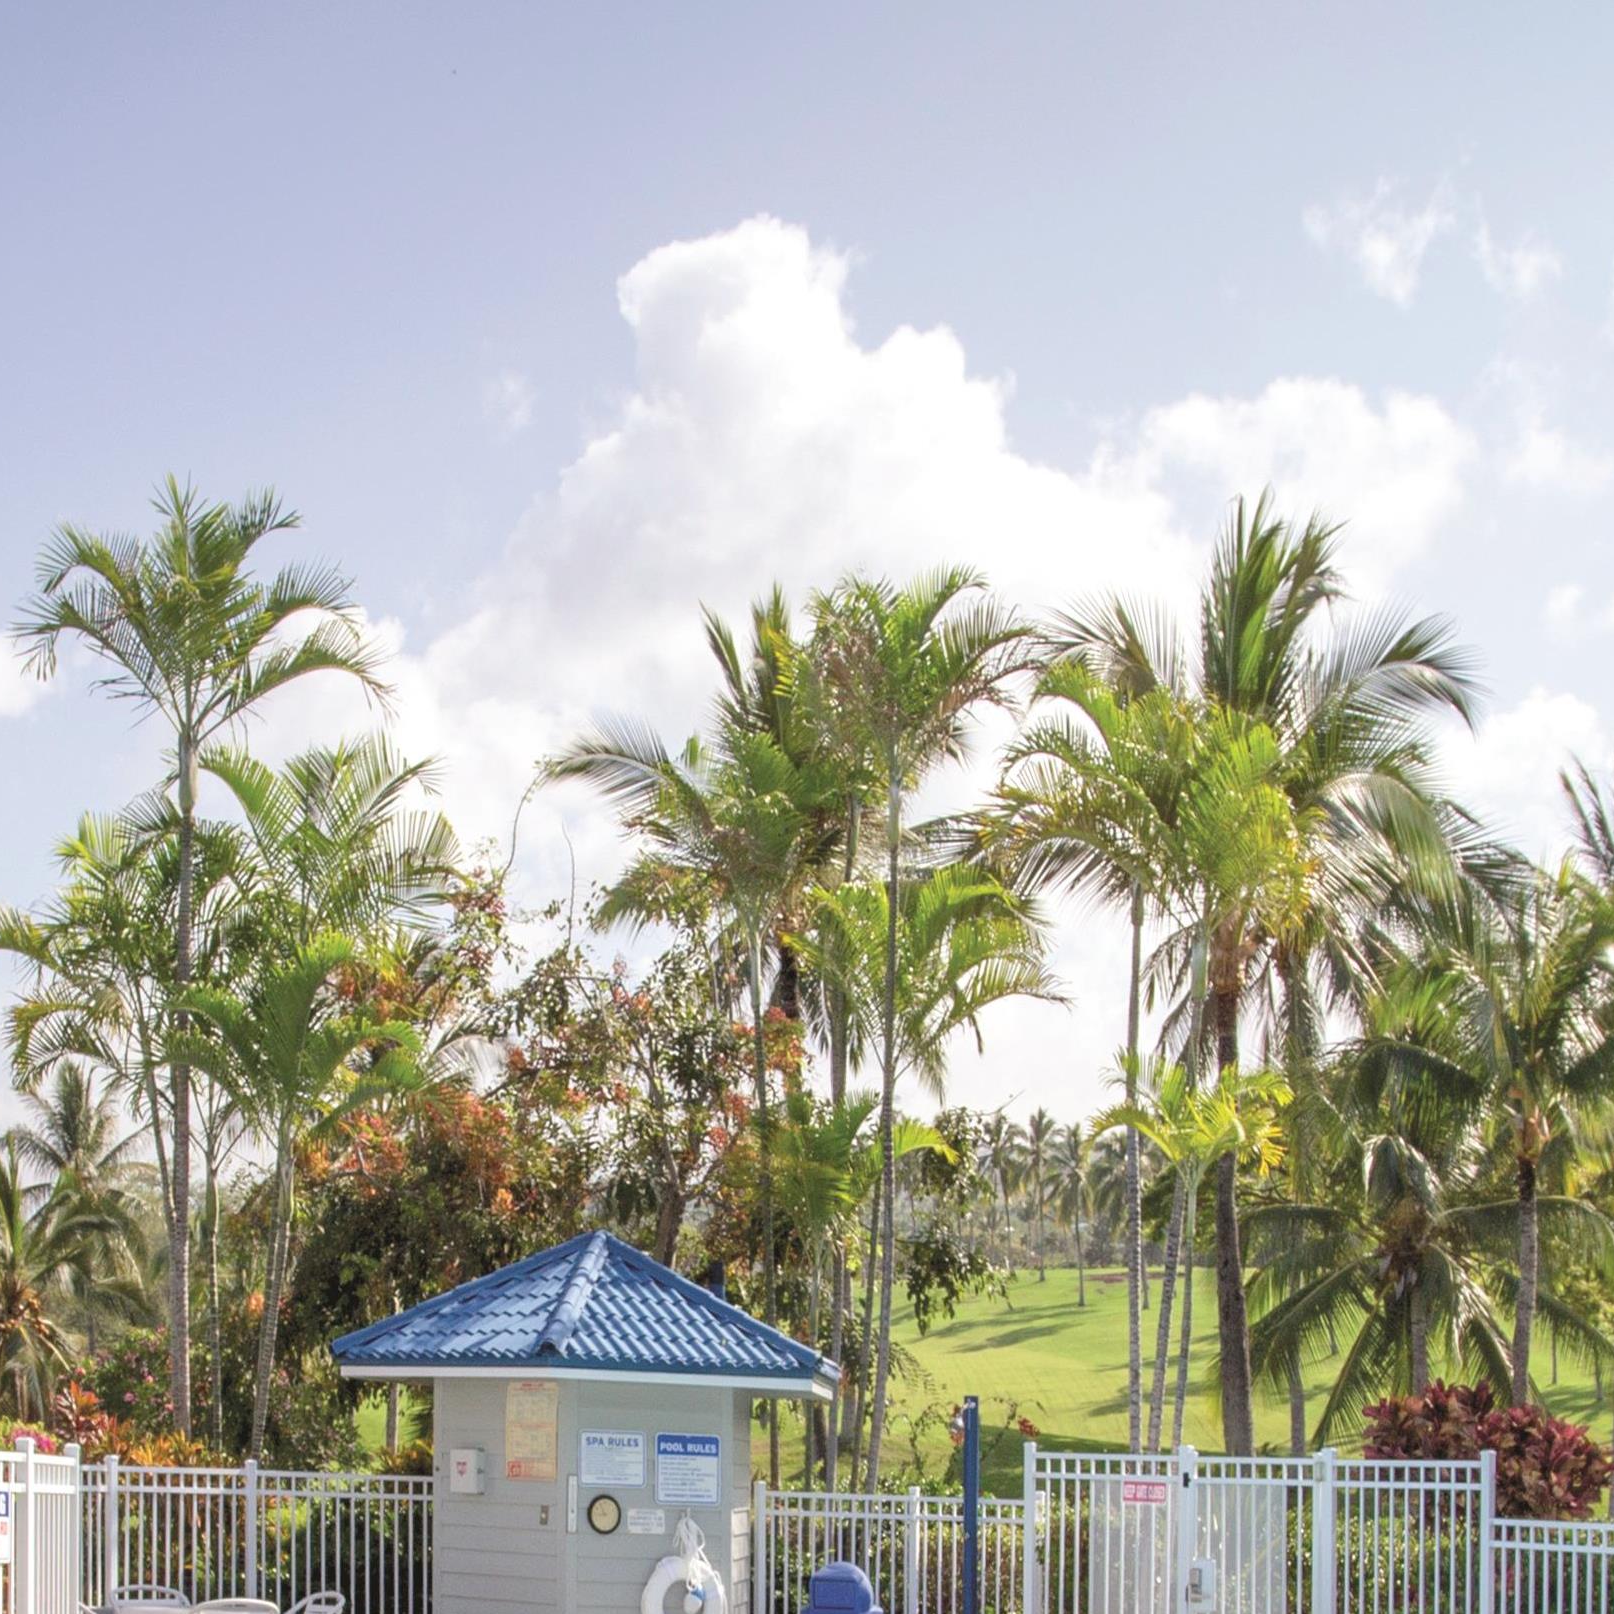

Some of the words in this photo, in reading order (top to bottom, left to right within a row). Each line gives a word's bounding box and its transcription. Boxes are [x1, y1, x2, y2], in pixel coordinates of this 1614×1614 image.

[585, 1437, 604, 1446] SPA
[608, 1437, 639, 1447] RULES
[660, 1441, 684, 1452] POOL
[686, 1443, 717, 1454] RULES
